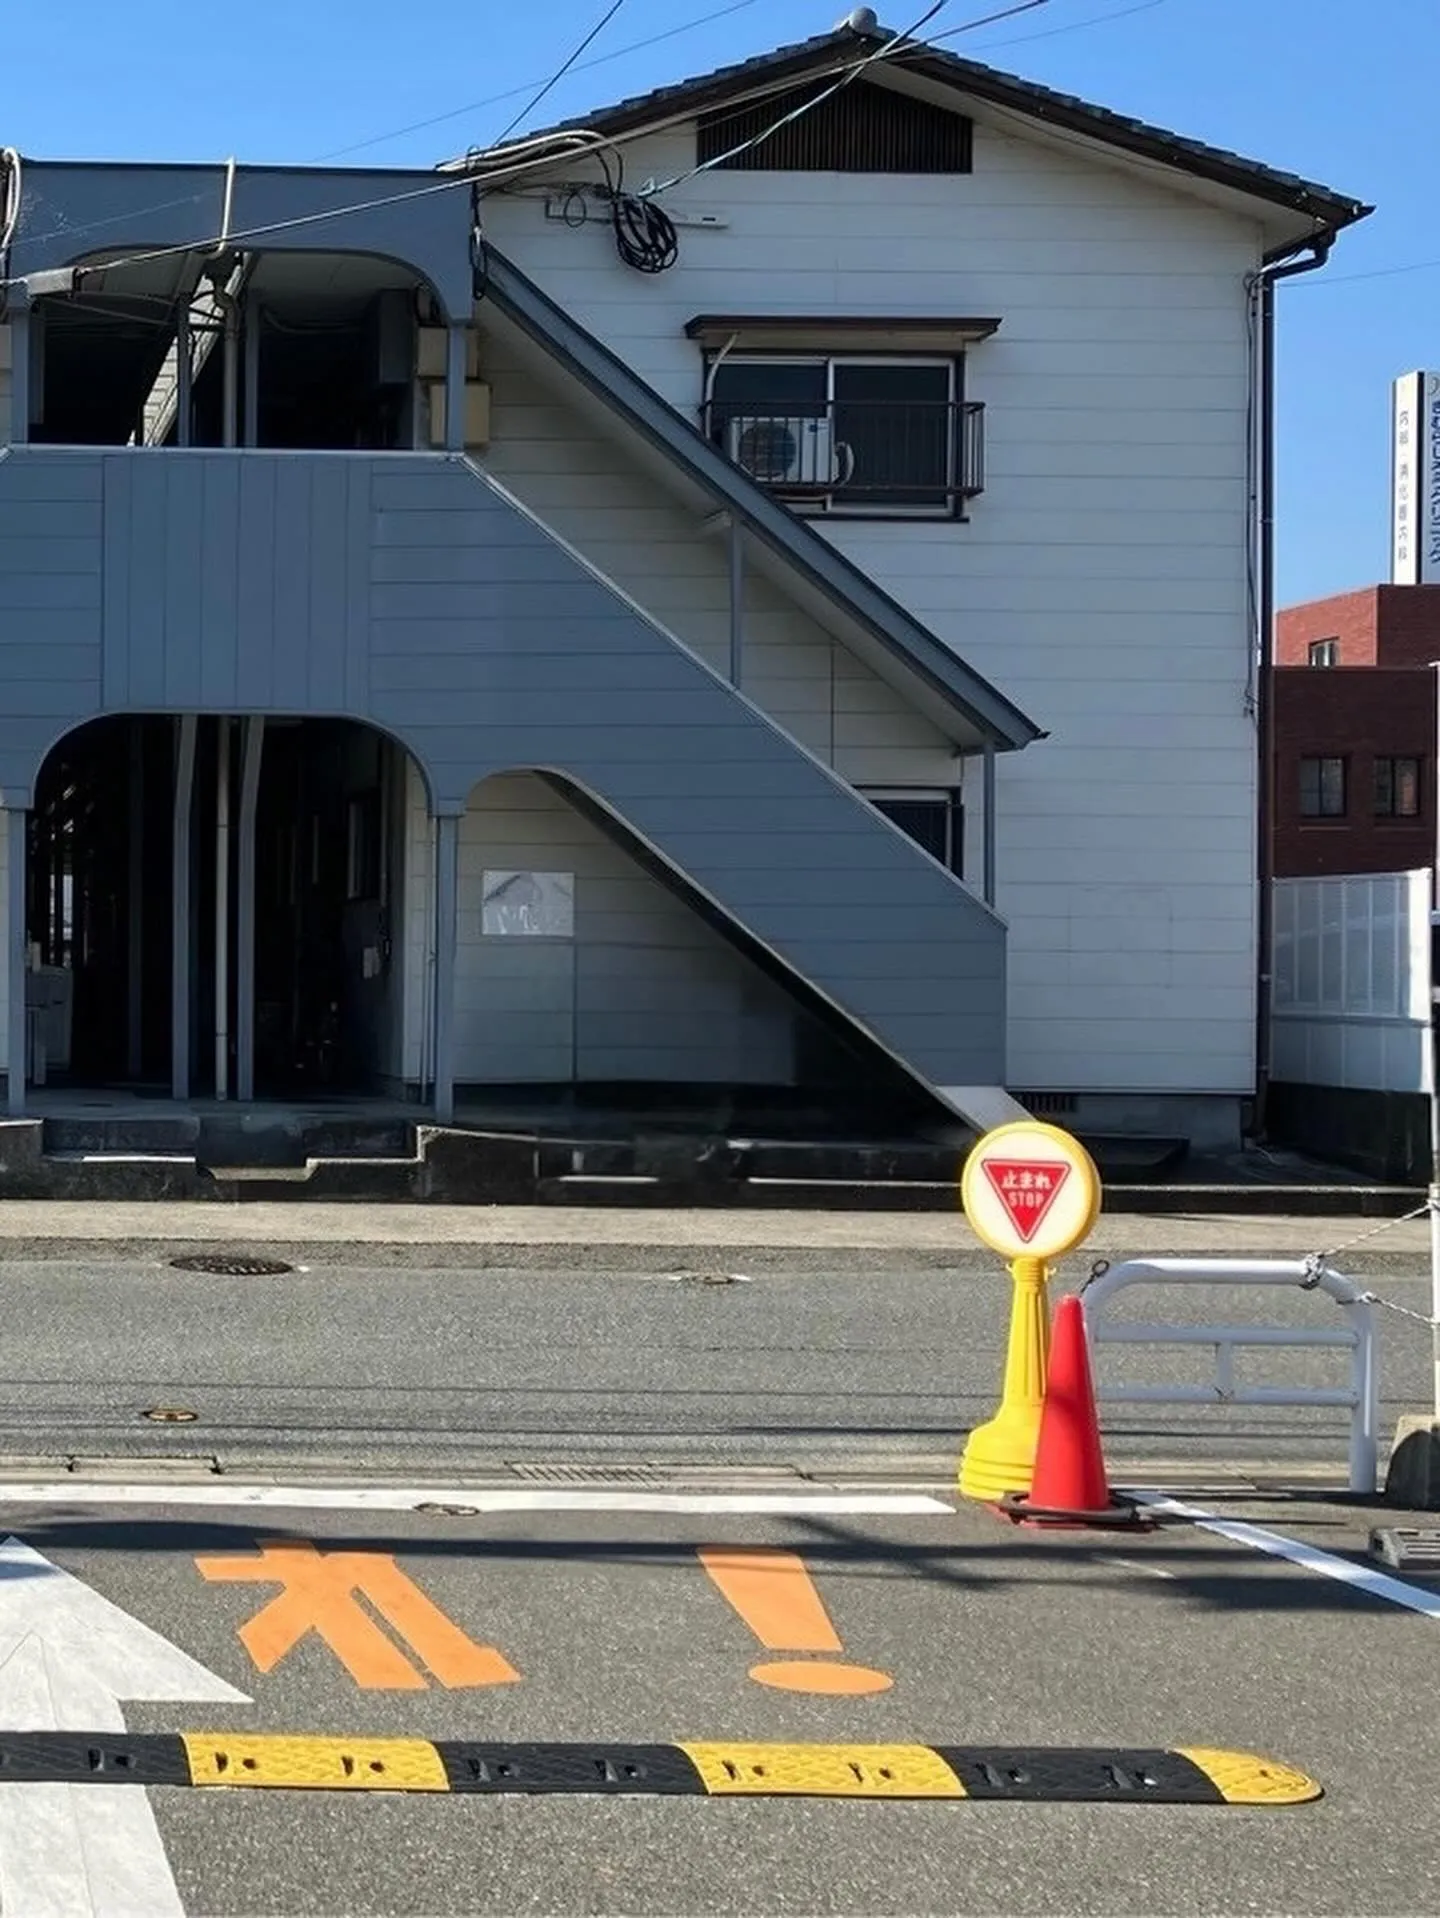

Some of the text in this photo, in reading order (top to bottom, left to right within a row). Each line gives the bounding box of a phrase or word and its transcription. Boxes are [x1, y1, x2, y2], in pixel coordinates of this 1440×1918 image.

[1001, 1169, 1053, 1189] 止まれ
[1008, 1191, 1044, 1208] STOP
